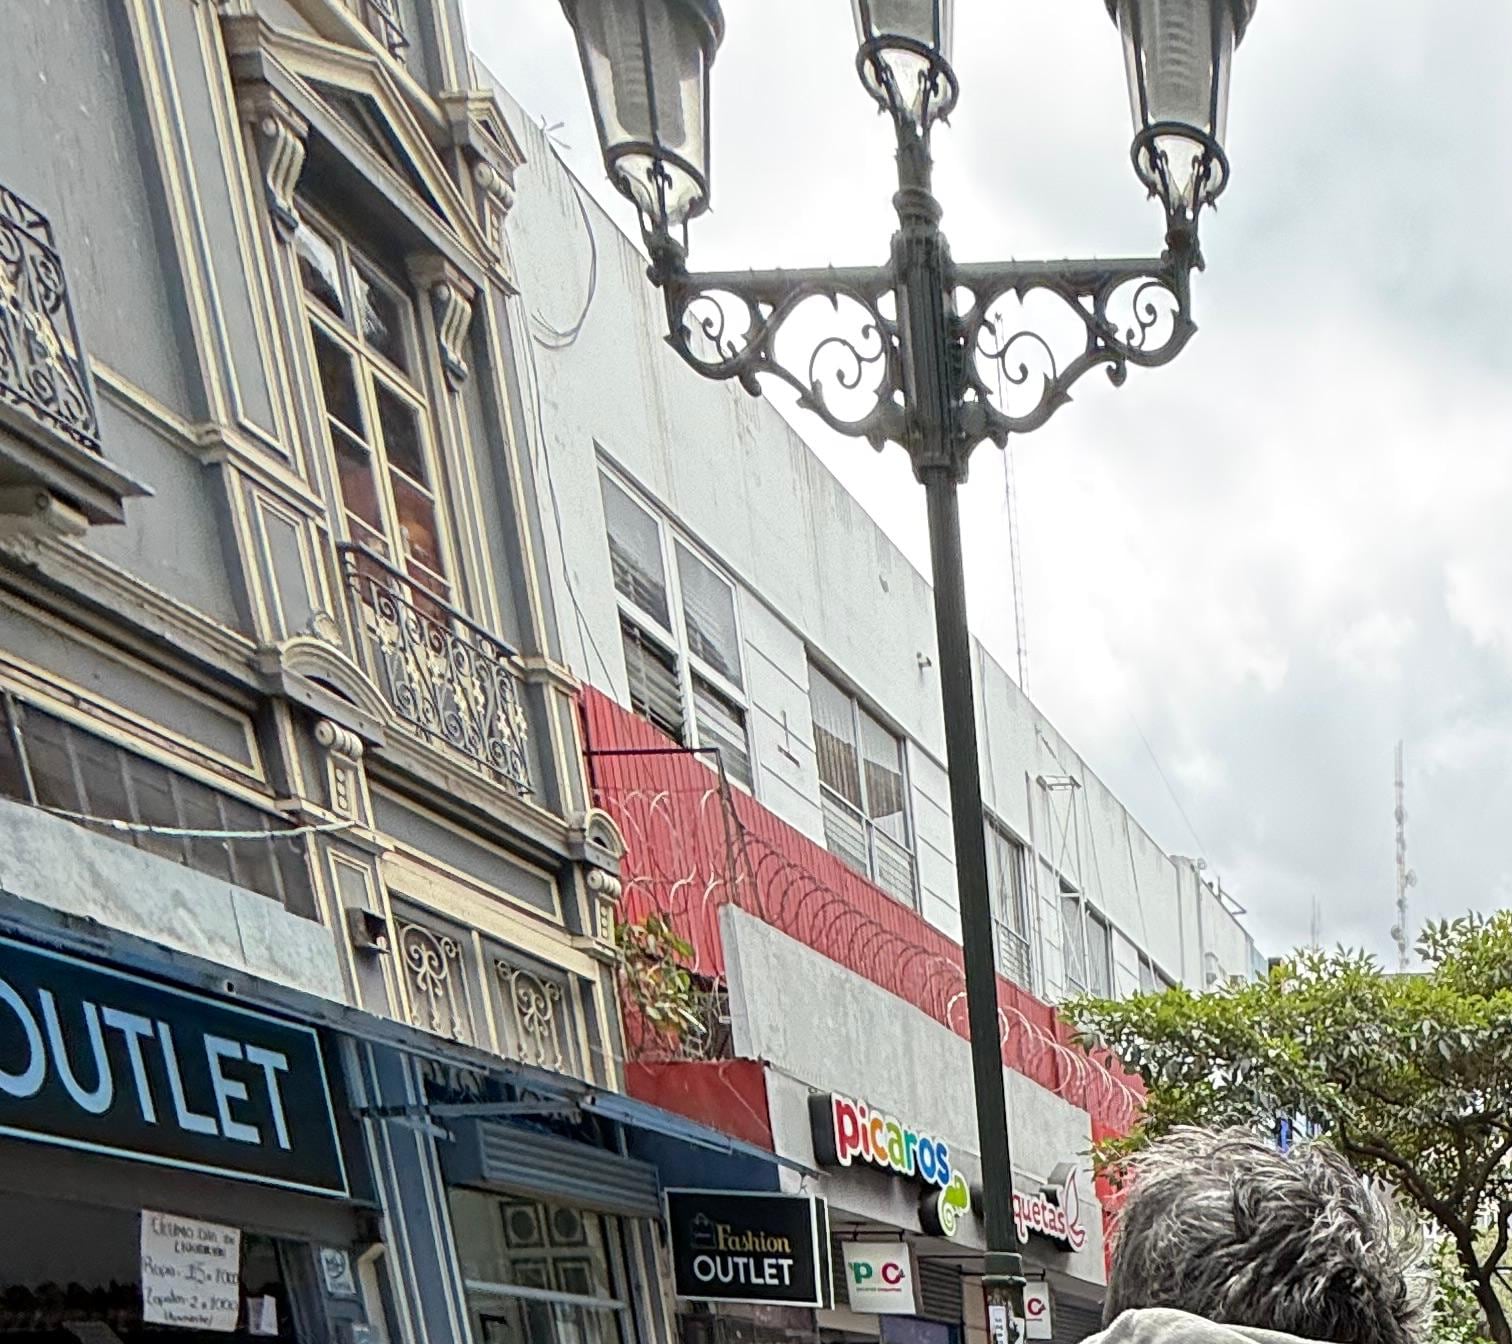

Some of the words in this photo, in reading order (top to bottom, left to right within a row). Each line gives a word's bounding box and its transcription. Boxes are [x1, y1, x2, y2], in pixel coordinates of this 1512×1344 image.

[835, 1099, 949, 1186] picaros
[717, 1223, 792, 1253] Fashion
[693, 1254, 793, 1286] OUTLET
